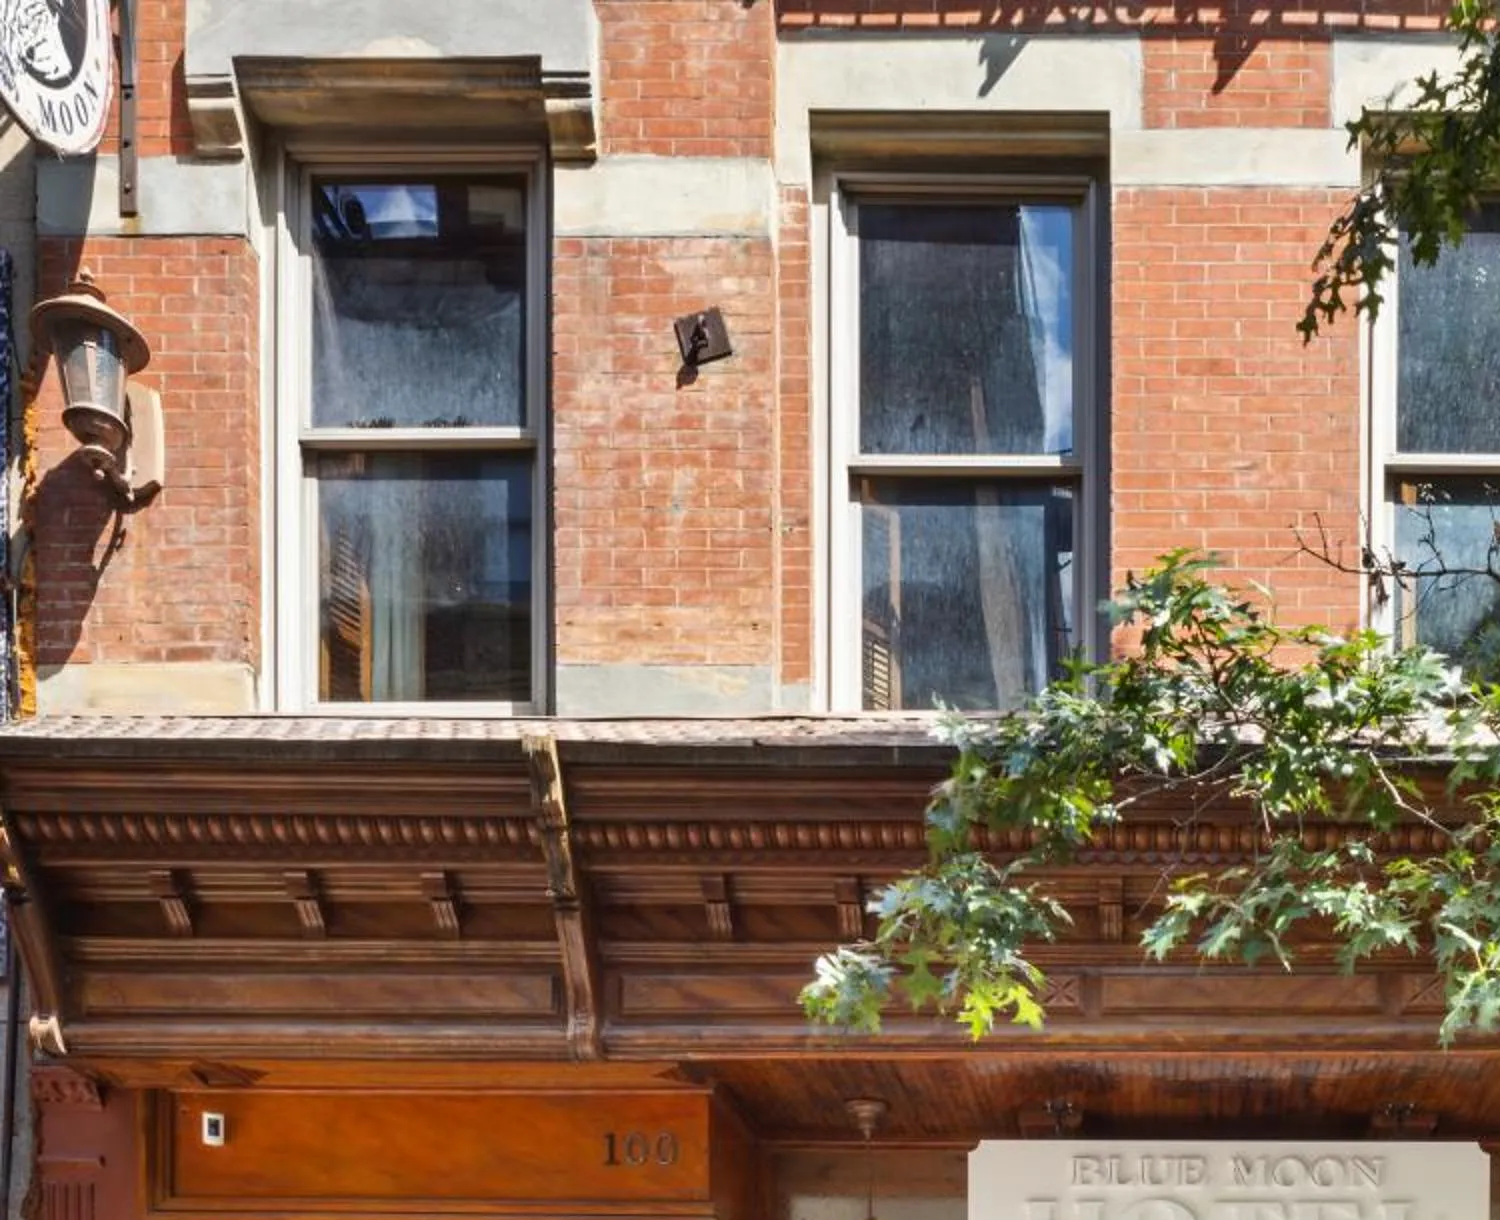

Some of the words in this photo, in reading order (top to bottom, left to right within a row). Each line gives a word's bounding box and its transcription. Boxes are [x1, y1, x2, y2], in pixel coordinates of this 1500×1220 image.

[38, 79, 99, 136] MOON
[604, 1132, 679, 1166] 100
[1071, 1152, 1206, 1187] BLUE
[1232, 1151, 1387, 1187] MOON
